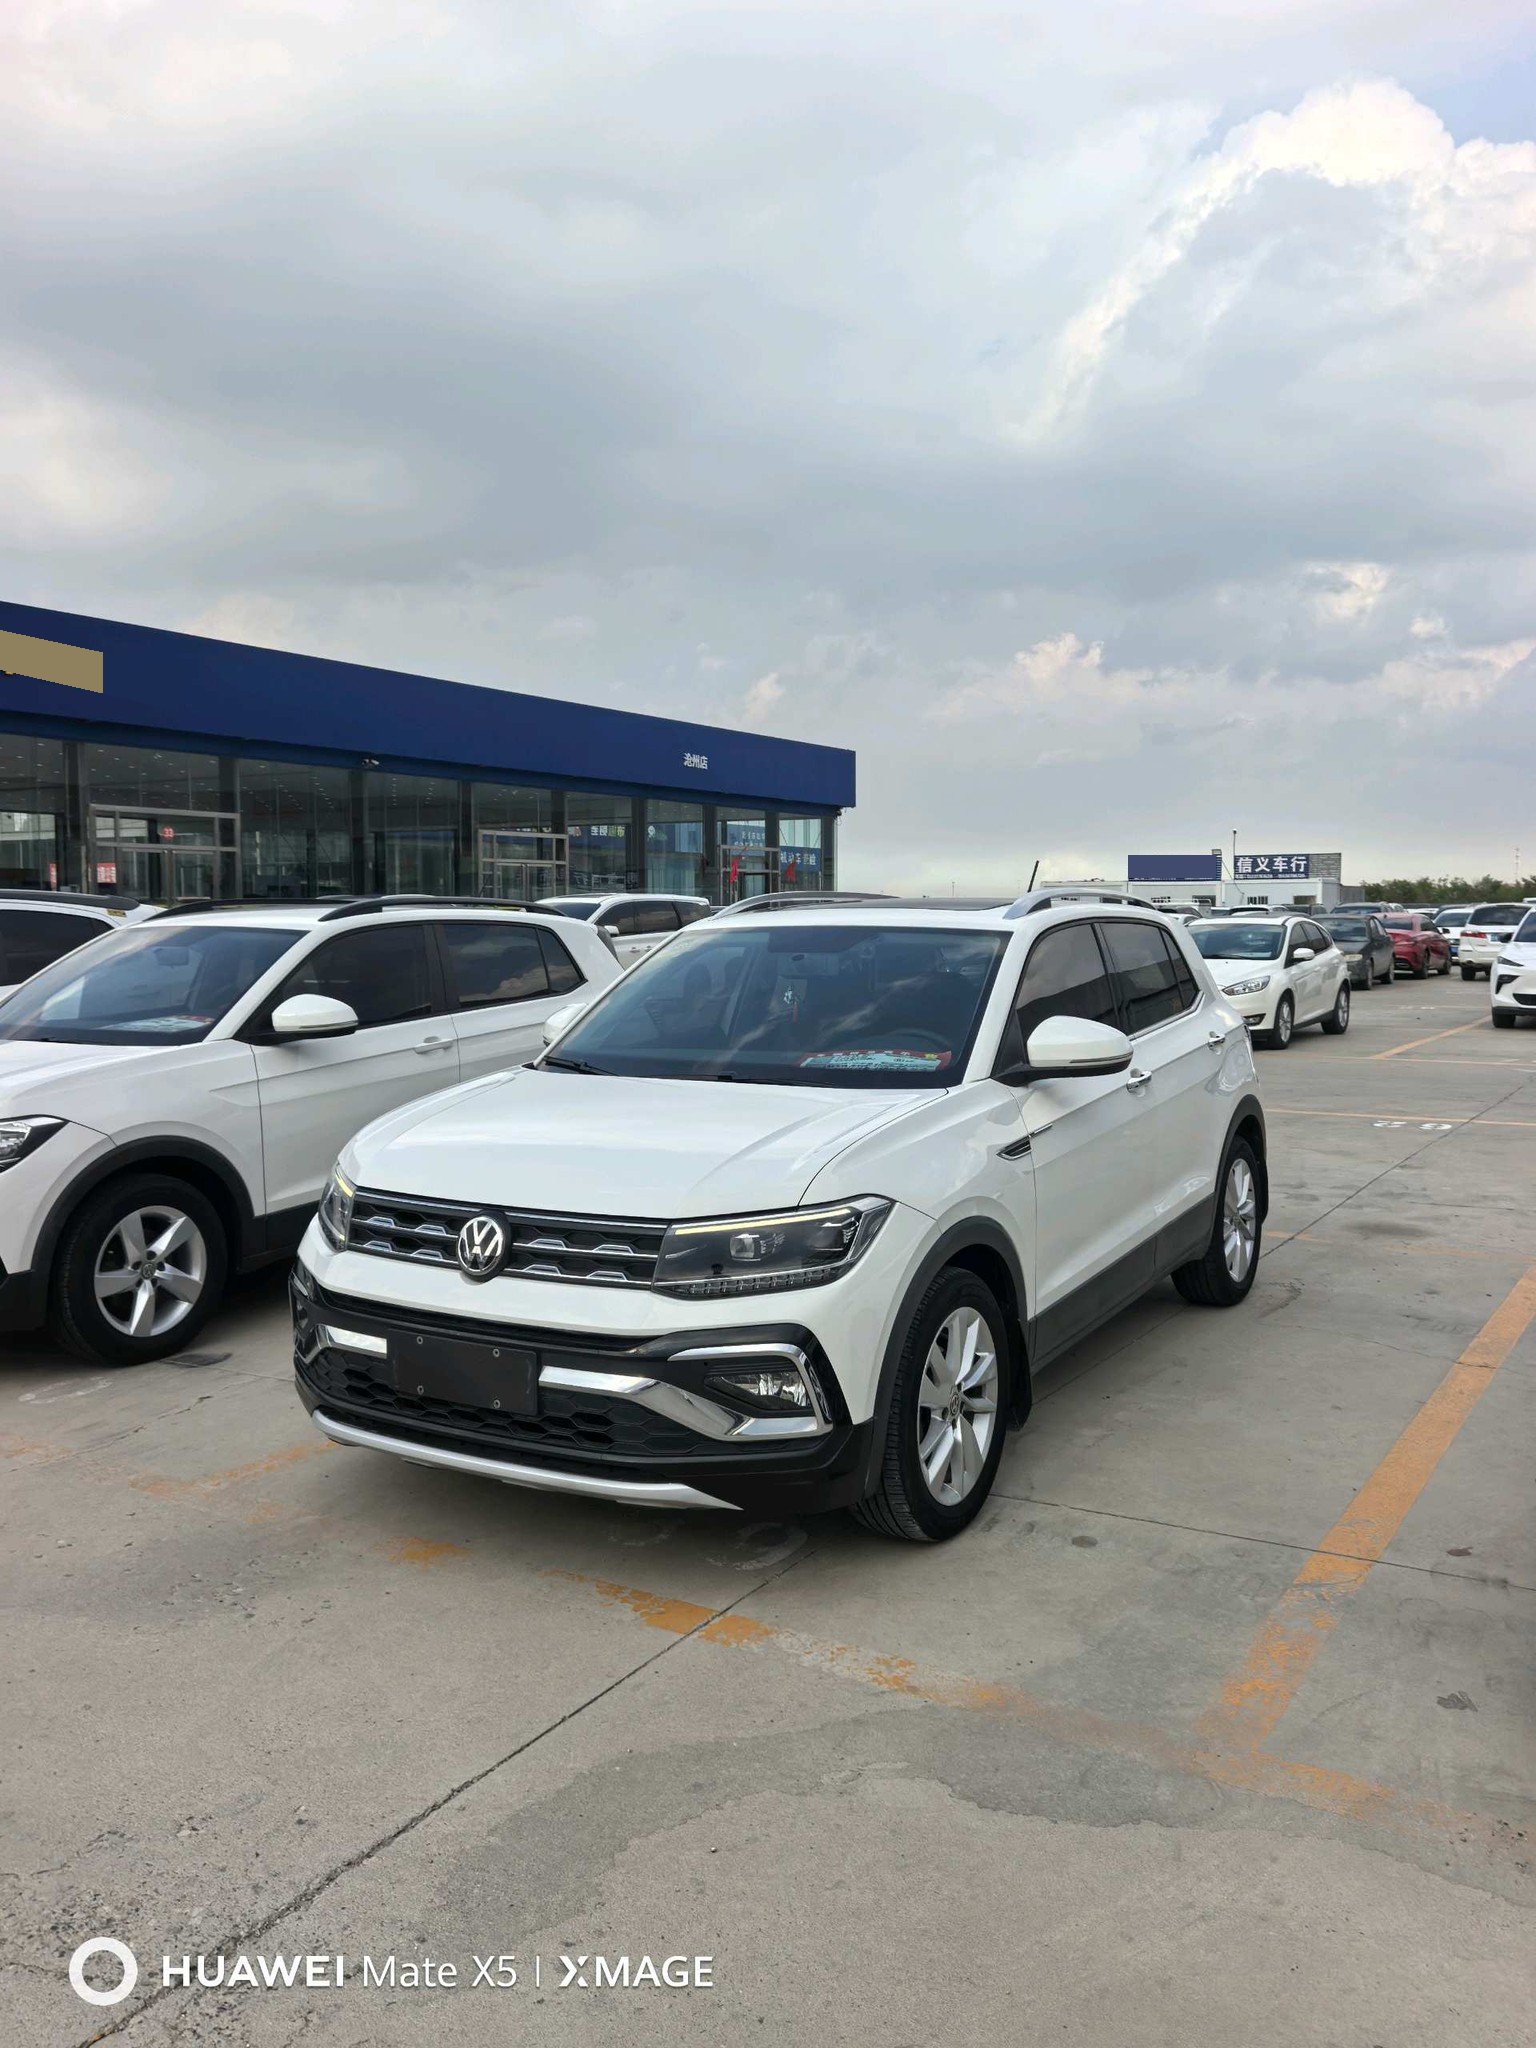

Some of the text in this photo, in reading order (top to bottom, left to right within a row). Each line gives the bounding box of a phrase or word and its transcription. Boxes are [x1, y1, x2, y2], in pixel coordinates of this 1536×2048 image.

[683, 752, 709, 770] 沧州店
[1237, 856, 1308, 873] 信义车行
